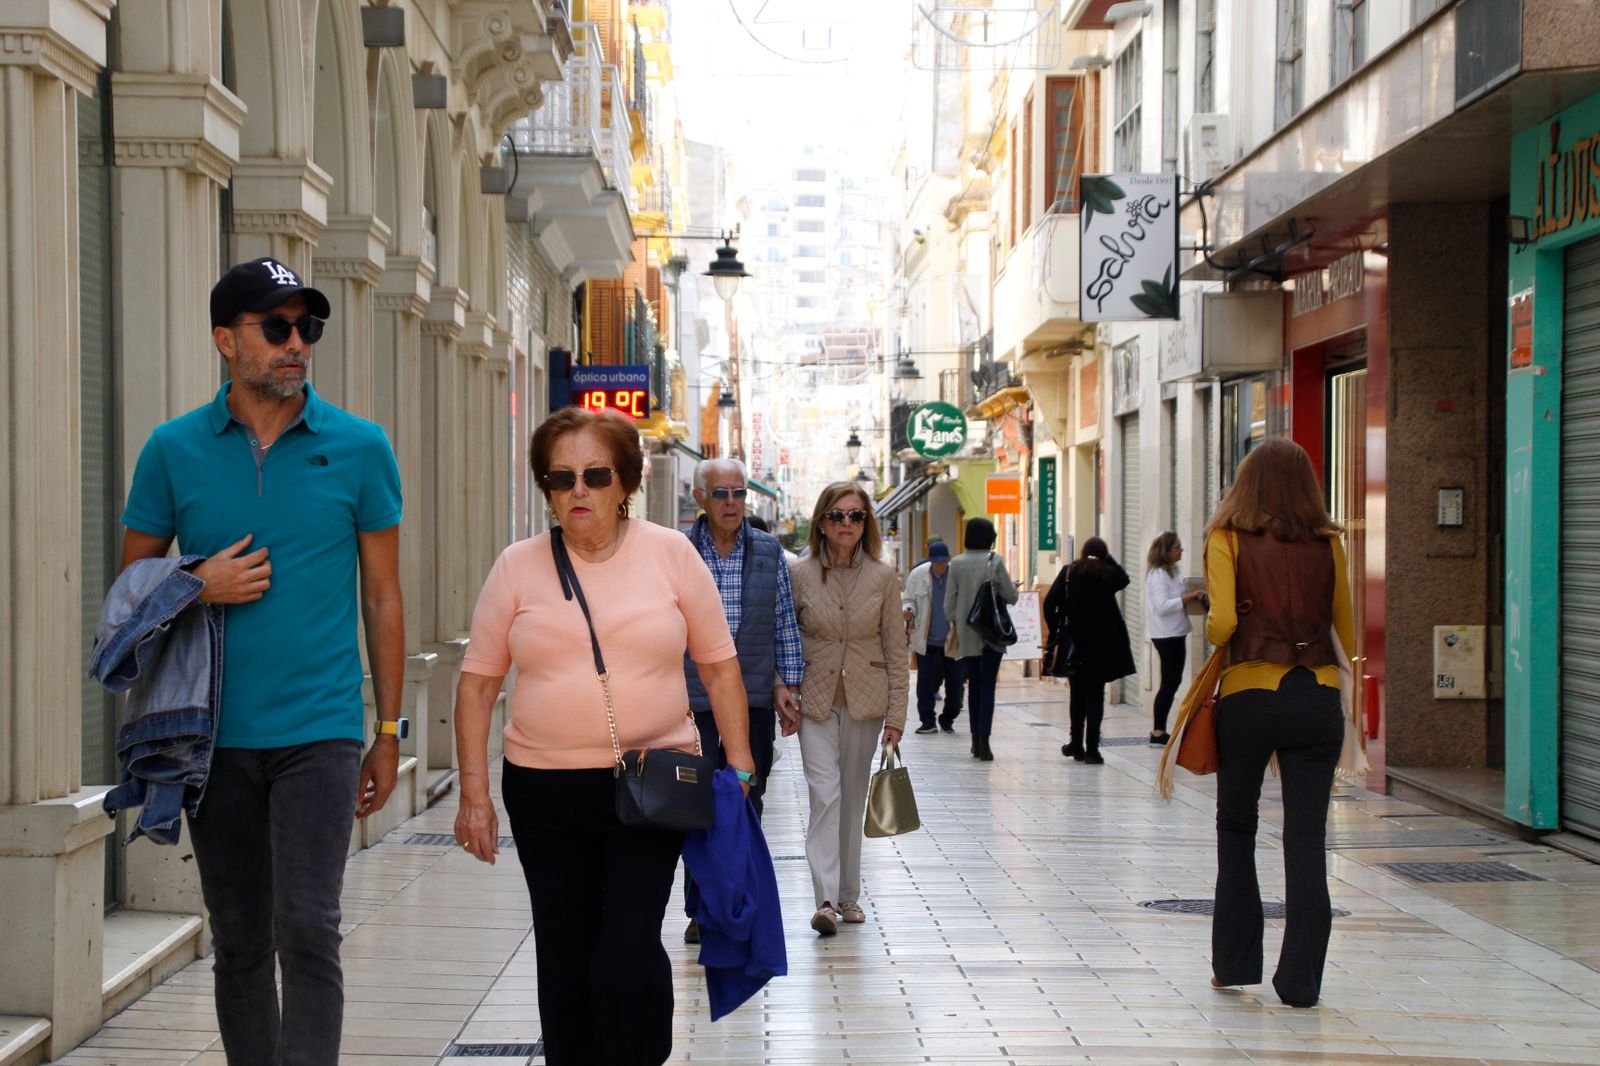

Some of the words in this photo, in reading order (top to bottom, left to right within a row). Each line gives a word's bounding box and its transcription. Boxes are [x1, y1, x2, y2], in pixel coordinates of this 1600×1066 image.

[1129, 176, 1153, 185] Desde
[1156, 176, 1173, 185] 1992
[262, 261, 298, 286] LA
[573, 371, 607, 384] óptica
[609, 371, 647, 382] urbano
[584, 391, 606, 411] 19
[1046, 463, 1054, 545] Herbolario
